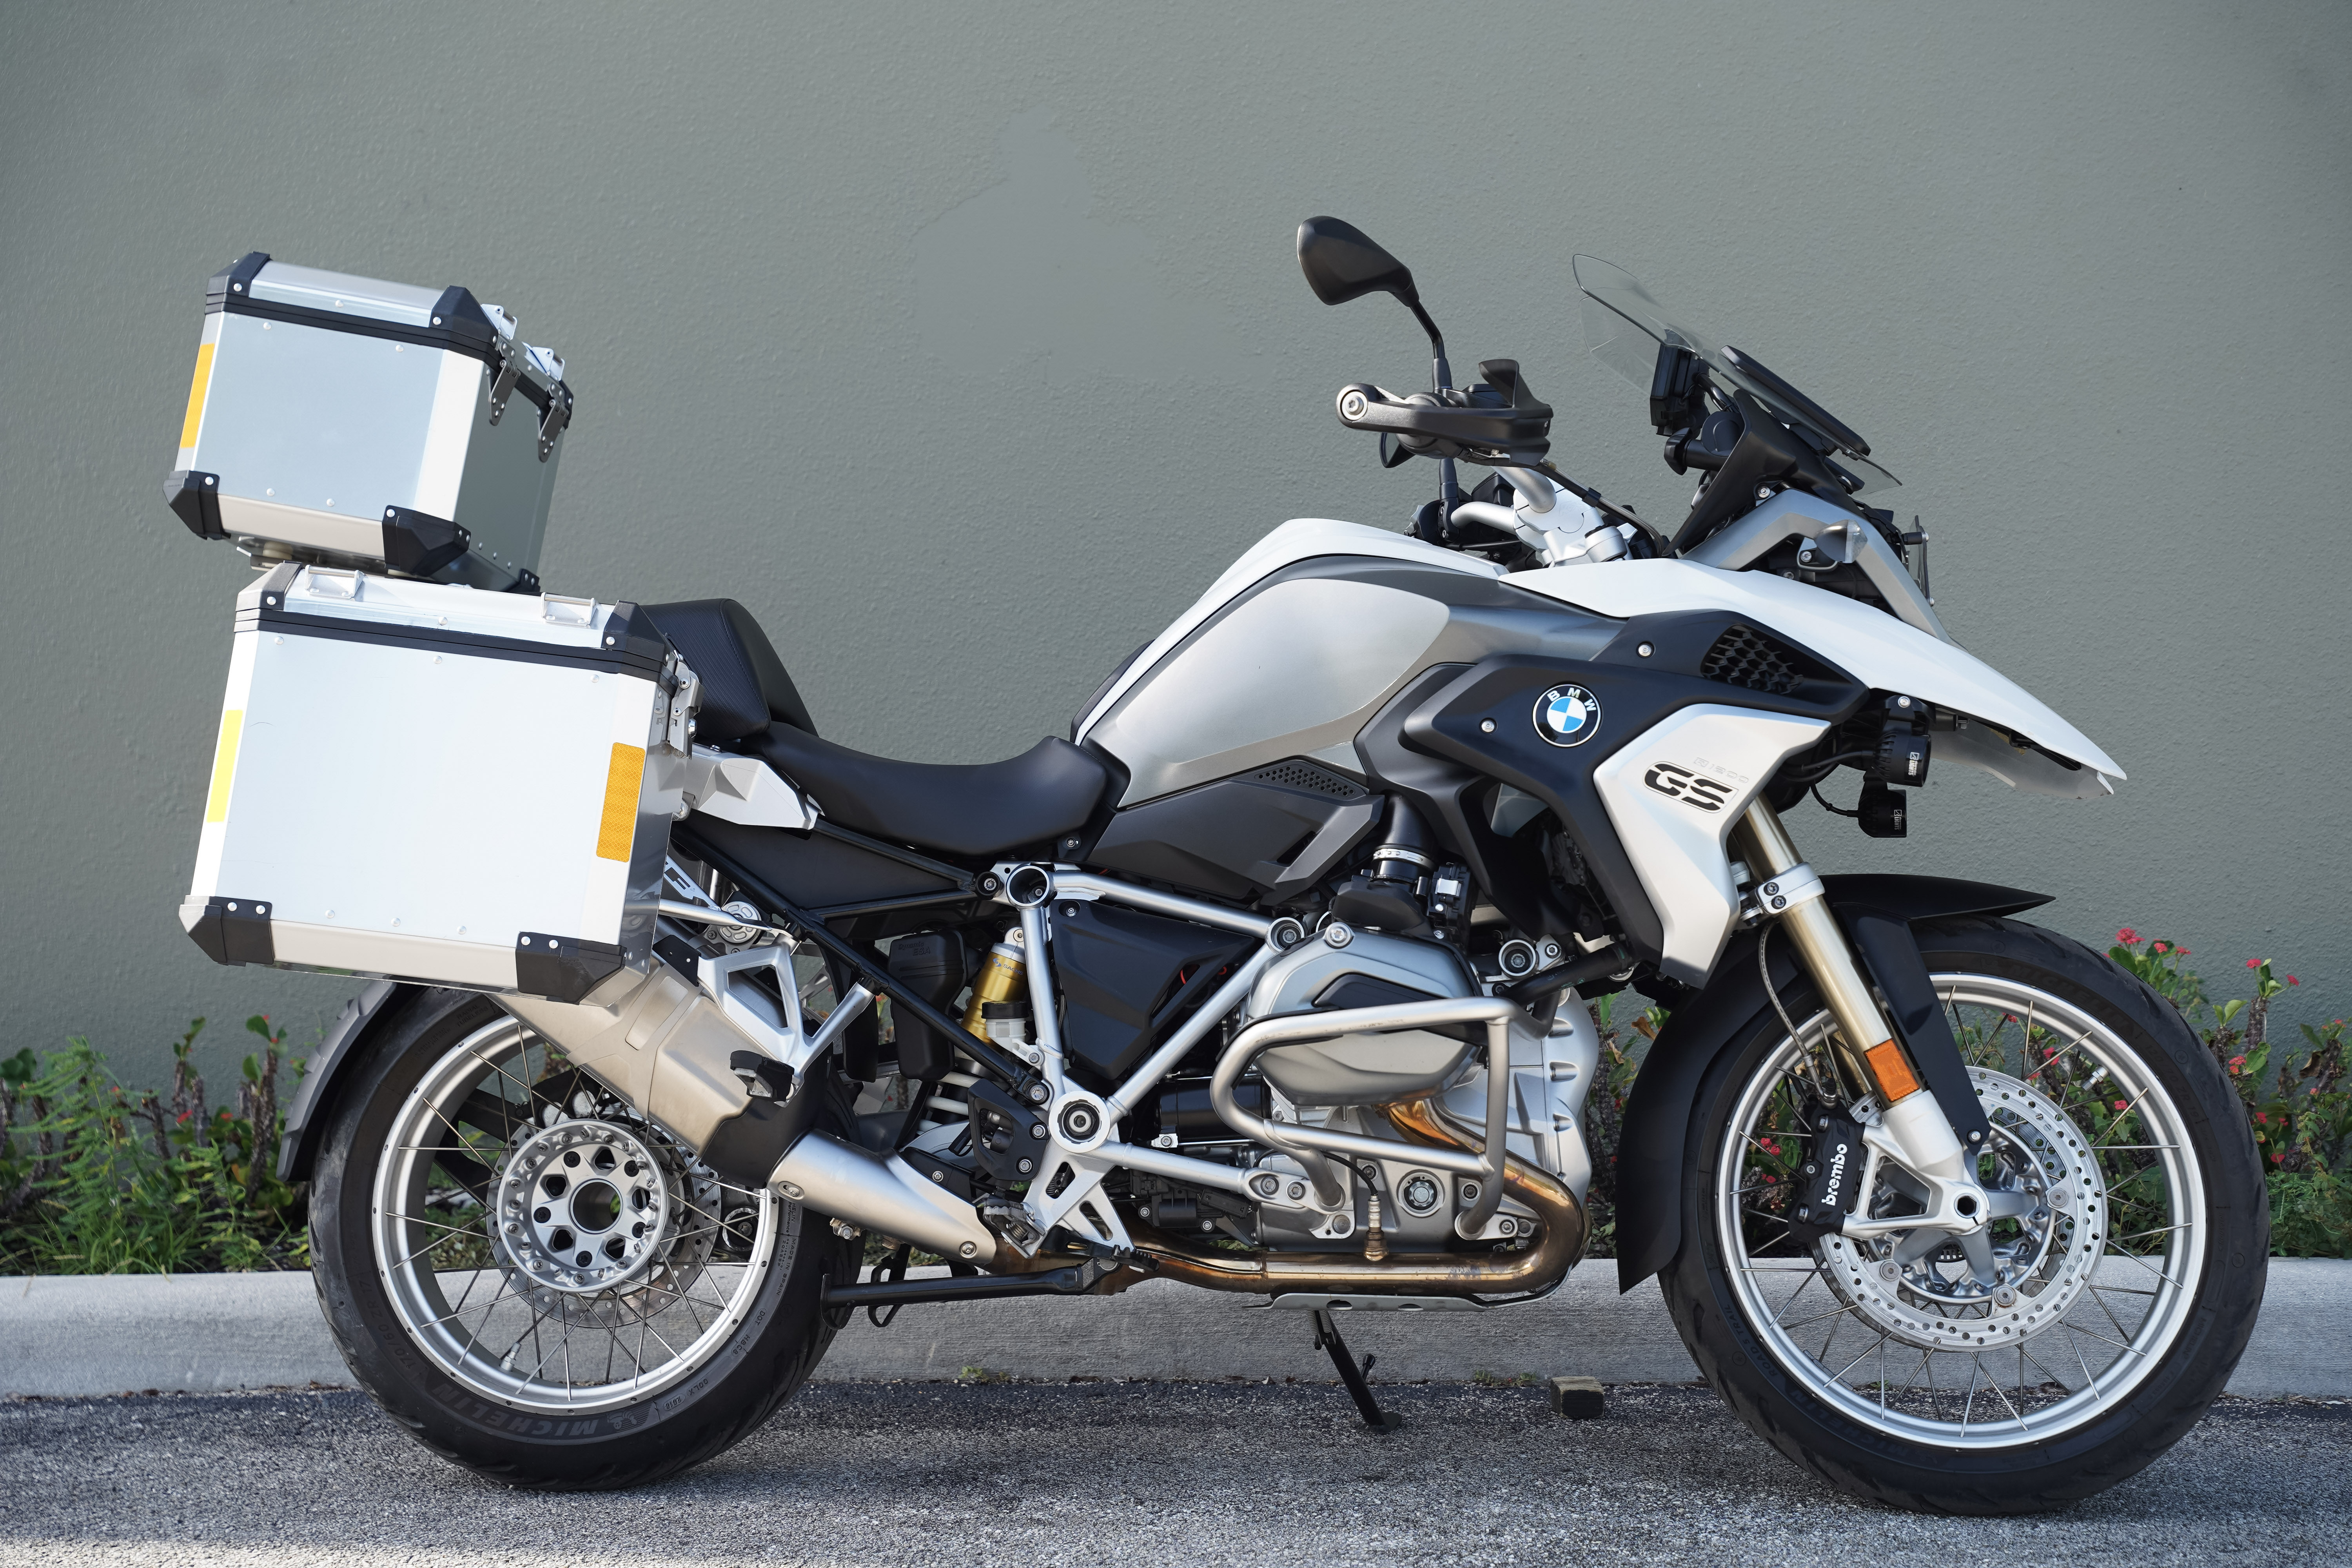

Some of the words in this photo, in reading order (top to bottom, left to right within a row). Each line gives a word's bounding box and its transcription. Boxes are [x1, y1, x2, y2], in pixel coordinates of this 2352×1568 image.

[1547, 687, 1597, 711] BMW
[1644, 763, 1733, 811] GS
[898, 941, 924, 950] Dynamic
[913, 947, 931, 956] ESA
[1003, 964, 1024, 975] SACHS
[1821, 1143, 1847, 1206] brembo
[788, 1238, 796, 1260] MADE
[785, 1262, 792, 1270] IN
[359, 1278, 373, 1294] 17
[776, 1272, 787, 1296] SPAIN
[366, 1301, 383, 1319] ZR
[755, 1310, 766, 1326] DOT
[1724, 1304, 1744, 1335] TRAIL
[378, 1323, 417, 1369] 170/60
[733, 1334, 750, 1355] HBC8
[1750, 1345, 1779, 1377] ROAD
[432, 1383, 599, 1436] MICHELIN
[1790, 1390, 1908, 1457] MICHELIN
